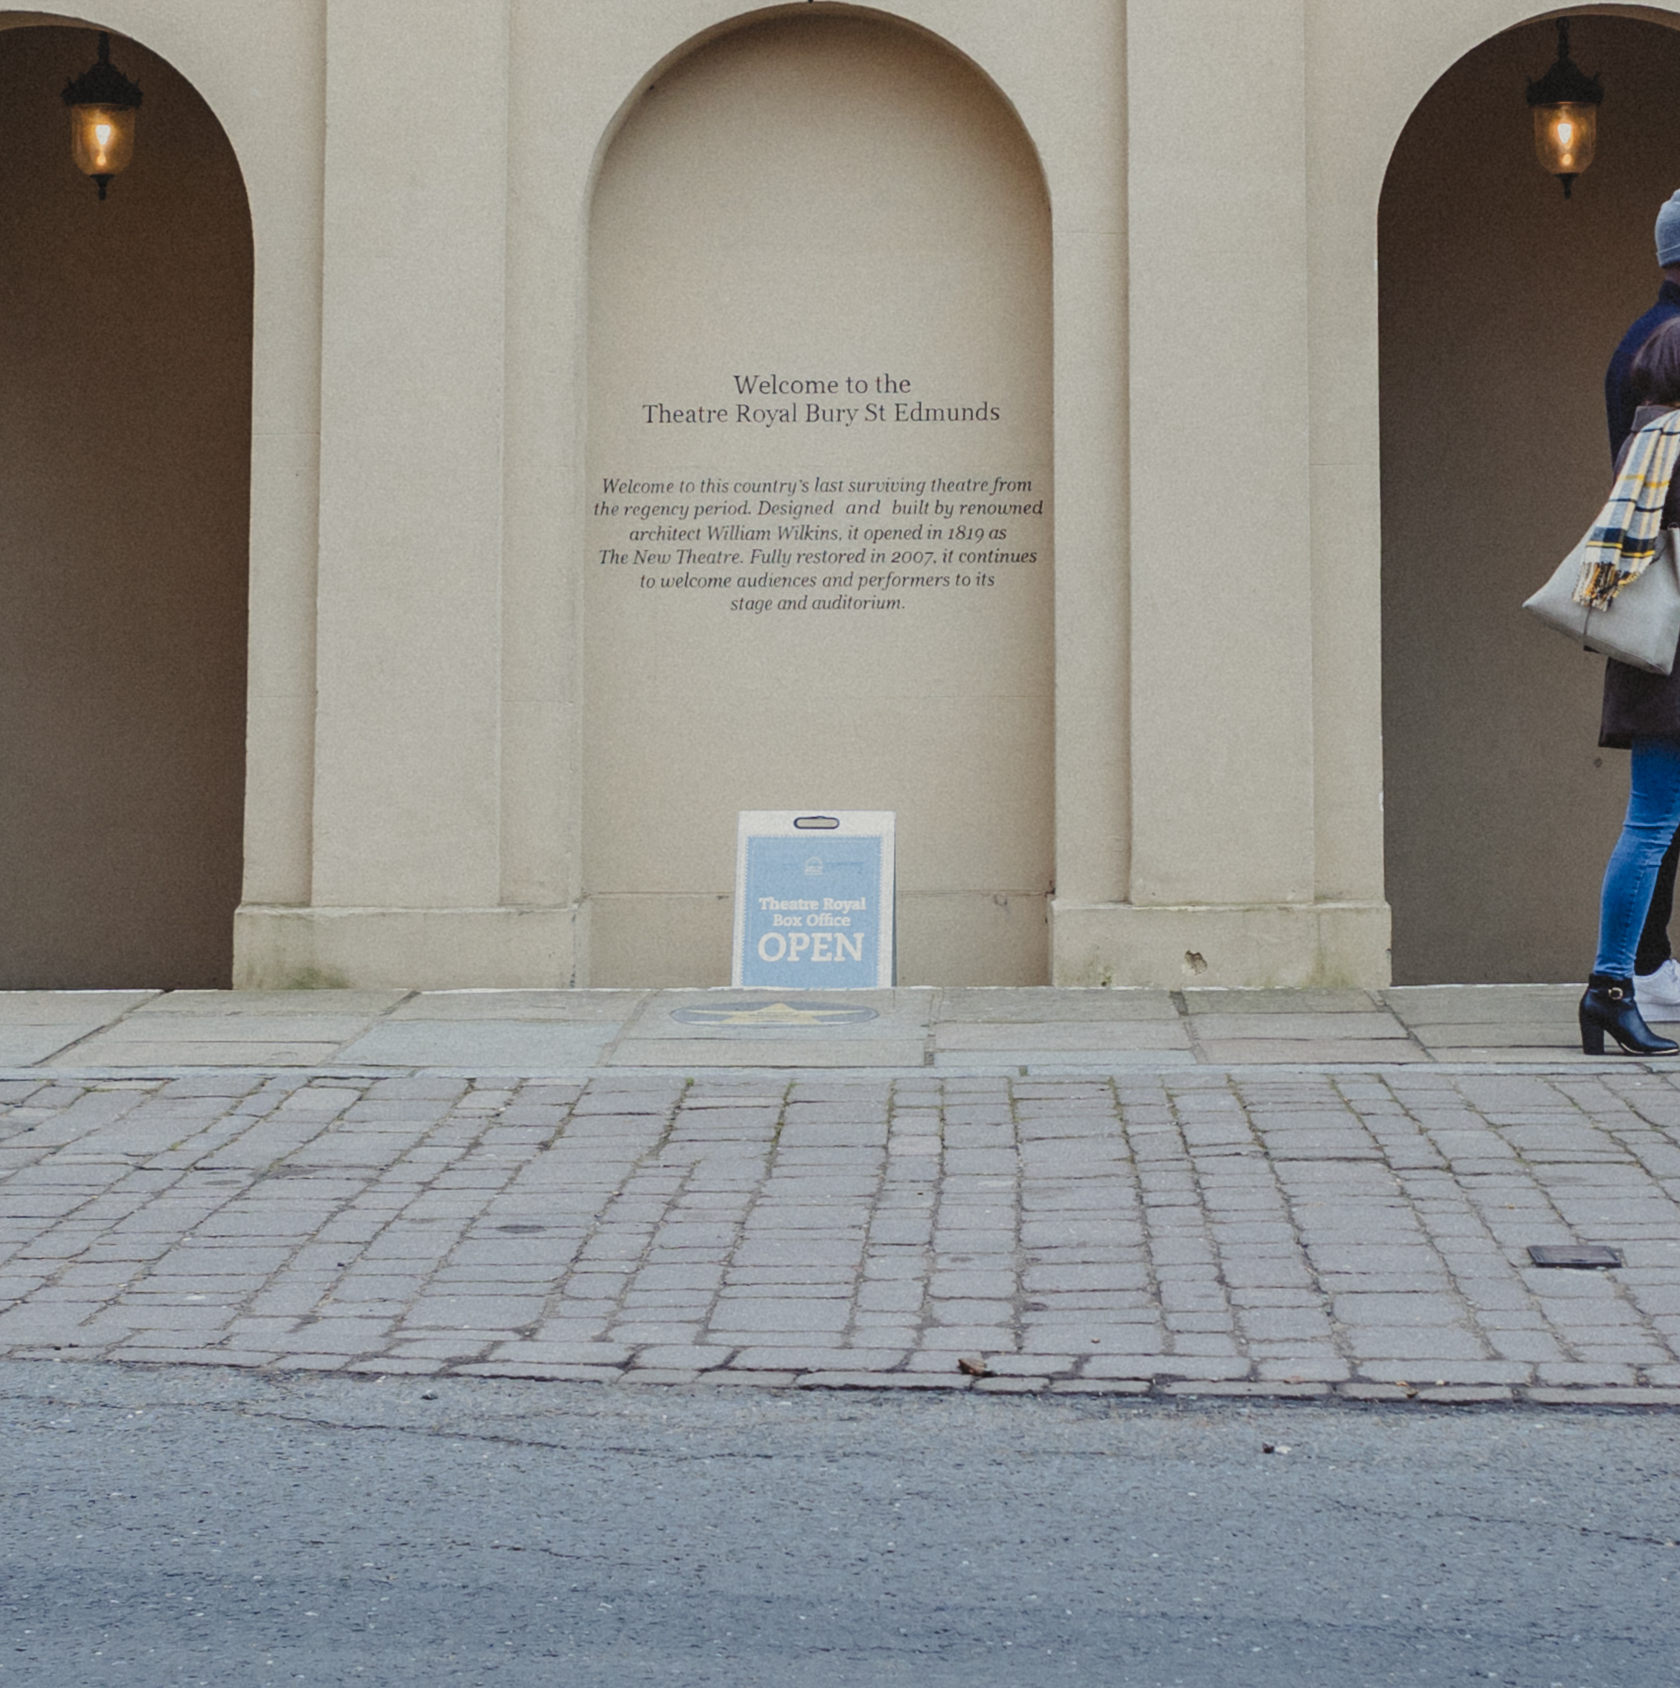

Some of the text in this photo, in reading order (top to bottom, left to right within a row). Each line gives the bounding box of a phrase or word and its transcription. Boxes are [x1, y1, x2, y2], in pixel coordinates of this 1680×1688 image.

[733, 374, 911, 394] Welcome to the
[642, 402, 1000, 426] Theatre Royal Bury St Edmunds
[602, 477, 1032, 497] Welcome to this country's last surviving theatre from
[594, 500, 1043, 520] the regency period. Designed and built by renowned
[629, 525, 701, 541] architect
[707, 525, 771, 541] William
[847, 526, 859, 541] it
[864, 525, 923, 544] opened
[927, 526, 943, 541] in
[948, 525, 984, 544] 1819
[989, 530, 1007, 541] as
[599, 549, 629, 565] The
[633, 550, 671, 564] New
[676, 550, 744, 565] Theatre.
[749, 549, 792, 568] Fully
[796, 549, 866, 564] restored
[871, 550, 886, 564] in
[942, 550, 954, 564] it
[958, 549, 1037, 564] continues
[640, 572, 995, 591] to welcome audiences and performers to its
[730, 596, 905, 615] stage and auditorium.
[758, 897, 866, 915] Theatre Royal
[773, 914, 851, 926] Box Office
[757, 932, 865, 962] OPEN
